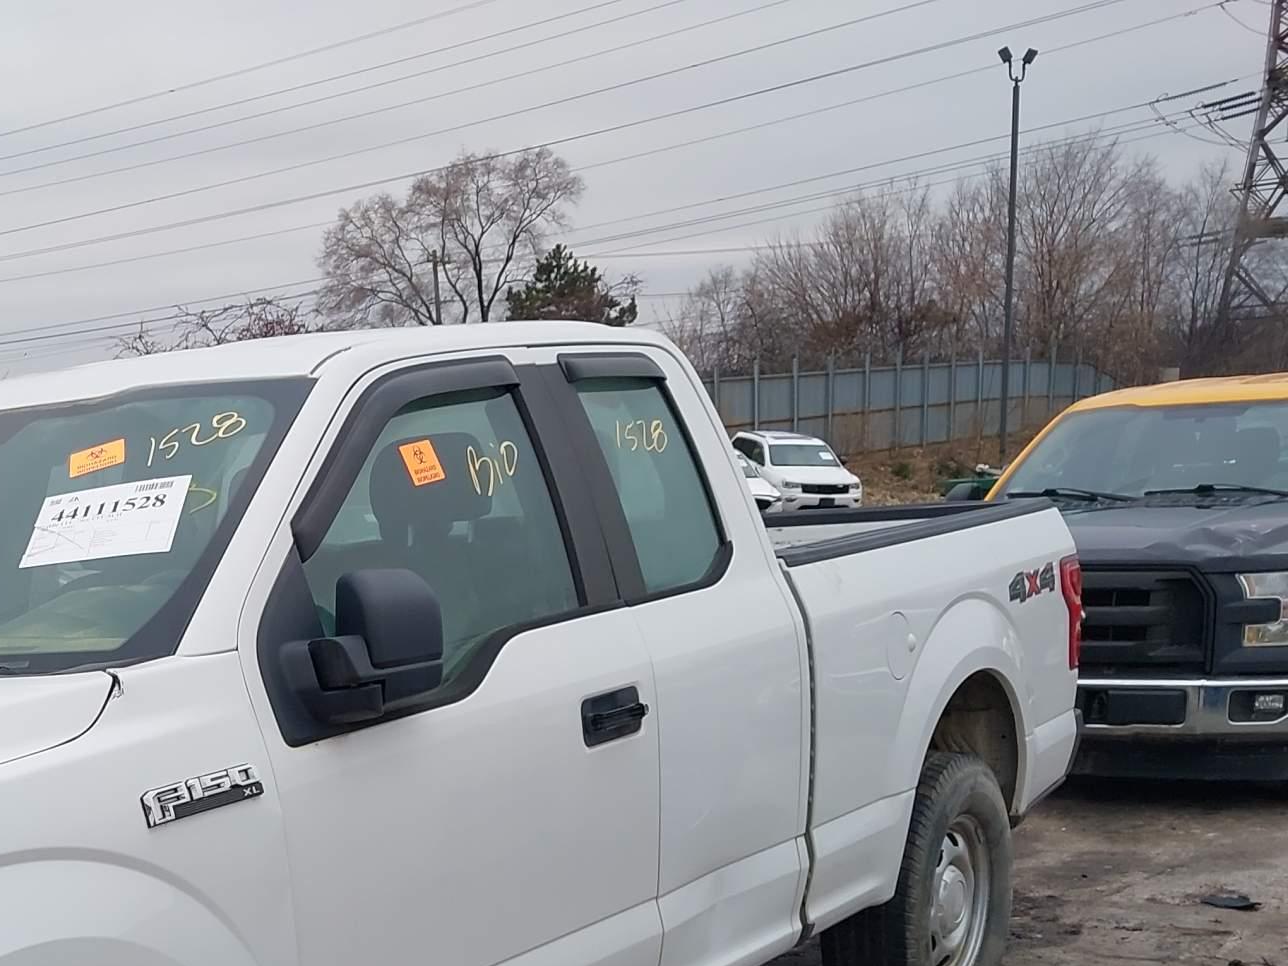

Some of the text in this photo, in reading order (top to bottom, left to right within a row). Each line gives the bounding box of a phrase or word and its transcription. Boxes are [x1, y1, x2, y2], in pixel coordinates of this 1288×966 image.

[147, 411, 246, 467] 1528
[616, 420, 668, 453] 1528
[51, 493, 168, 522] 44111528
[242, 784, 261, 796] XL
